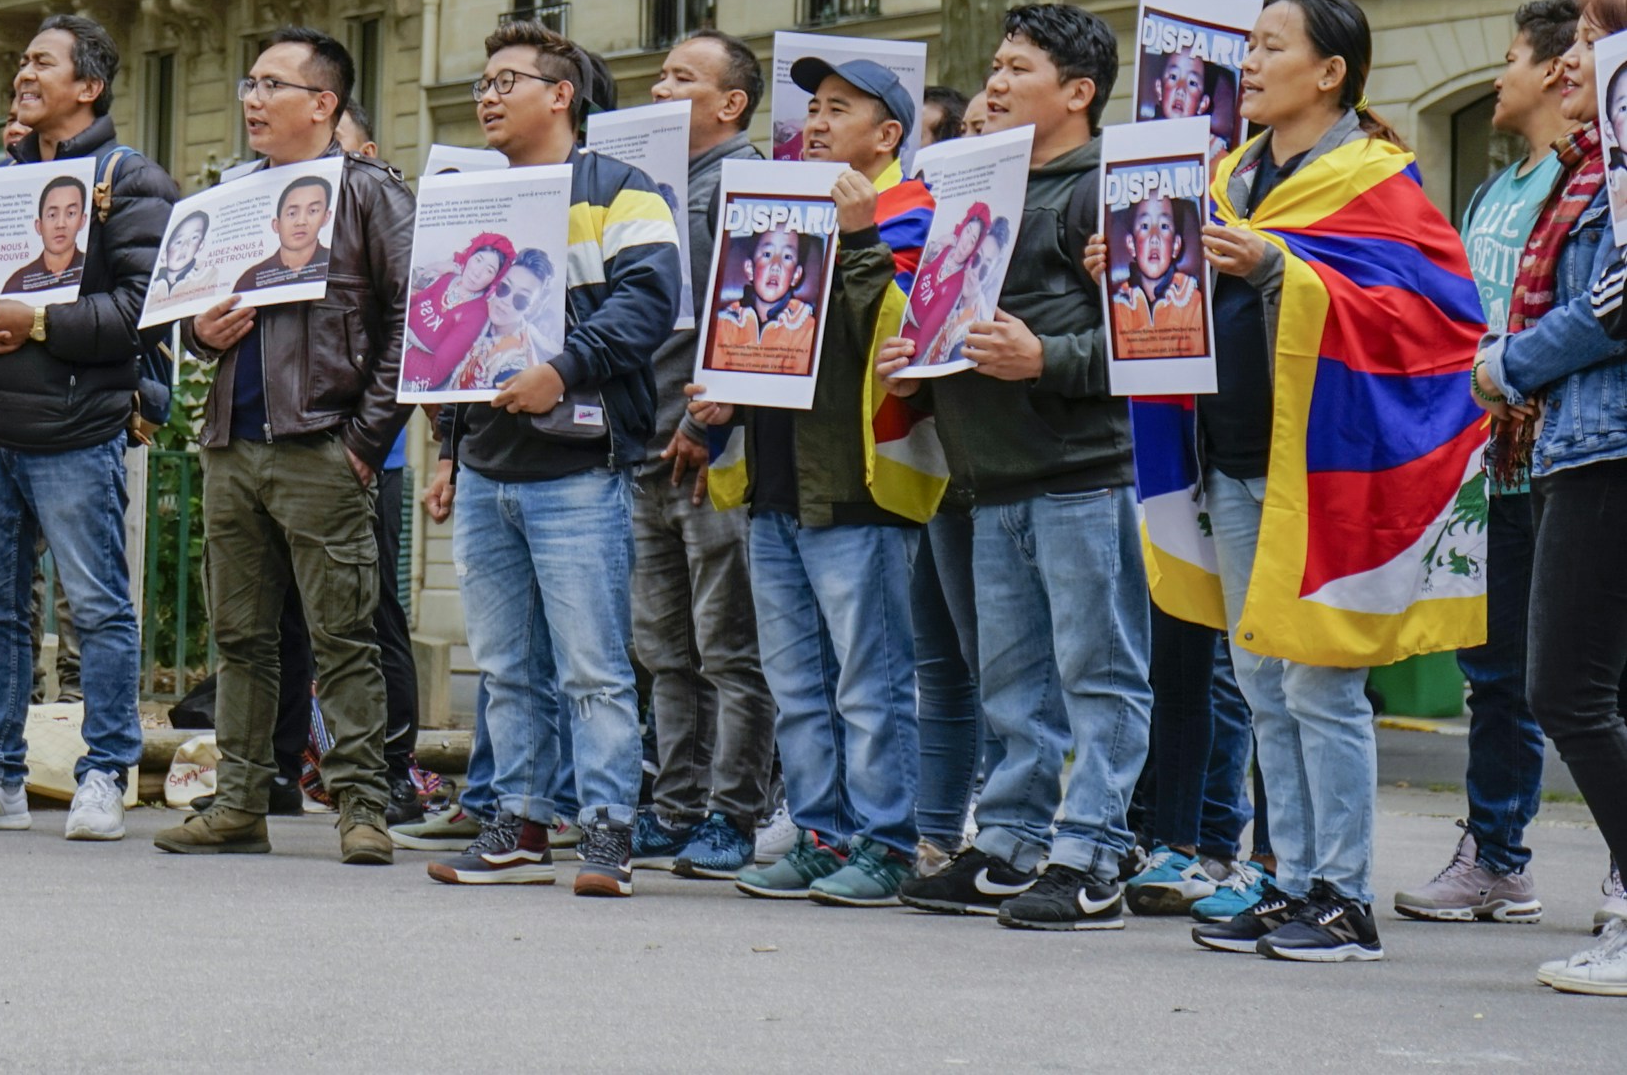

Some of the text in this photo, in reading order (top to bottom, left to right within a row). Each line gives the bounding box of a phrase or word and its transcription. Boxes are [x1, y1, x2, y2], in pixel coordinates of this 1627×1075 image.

[1142, 16, 1250, 69] DISPARU
[1105, 165, 1204, 205] DISPARU
[724, 203, 838, 235] DISPARU
[204, 249, 264, 267] LE RETROUVER
[208, 241, 256, 259] AIDEZ-NOUS
